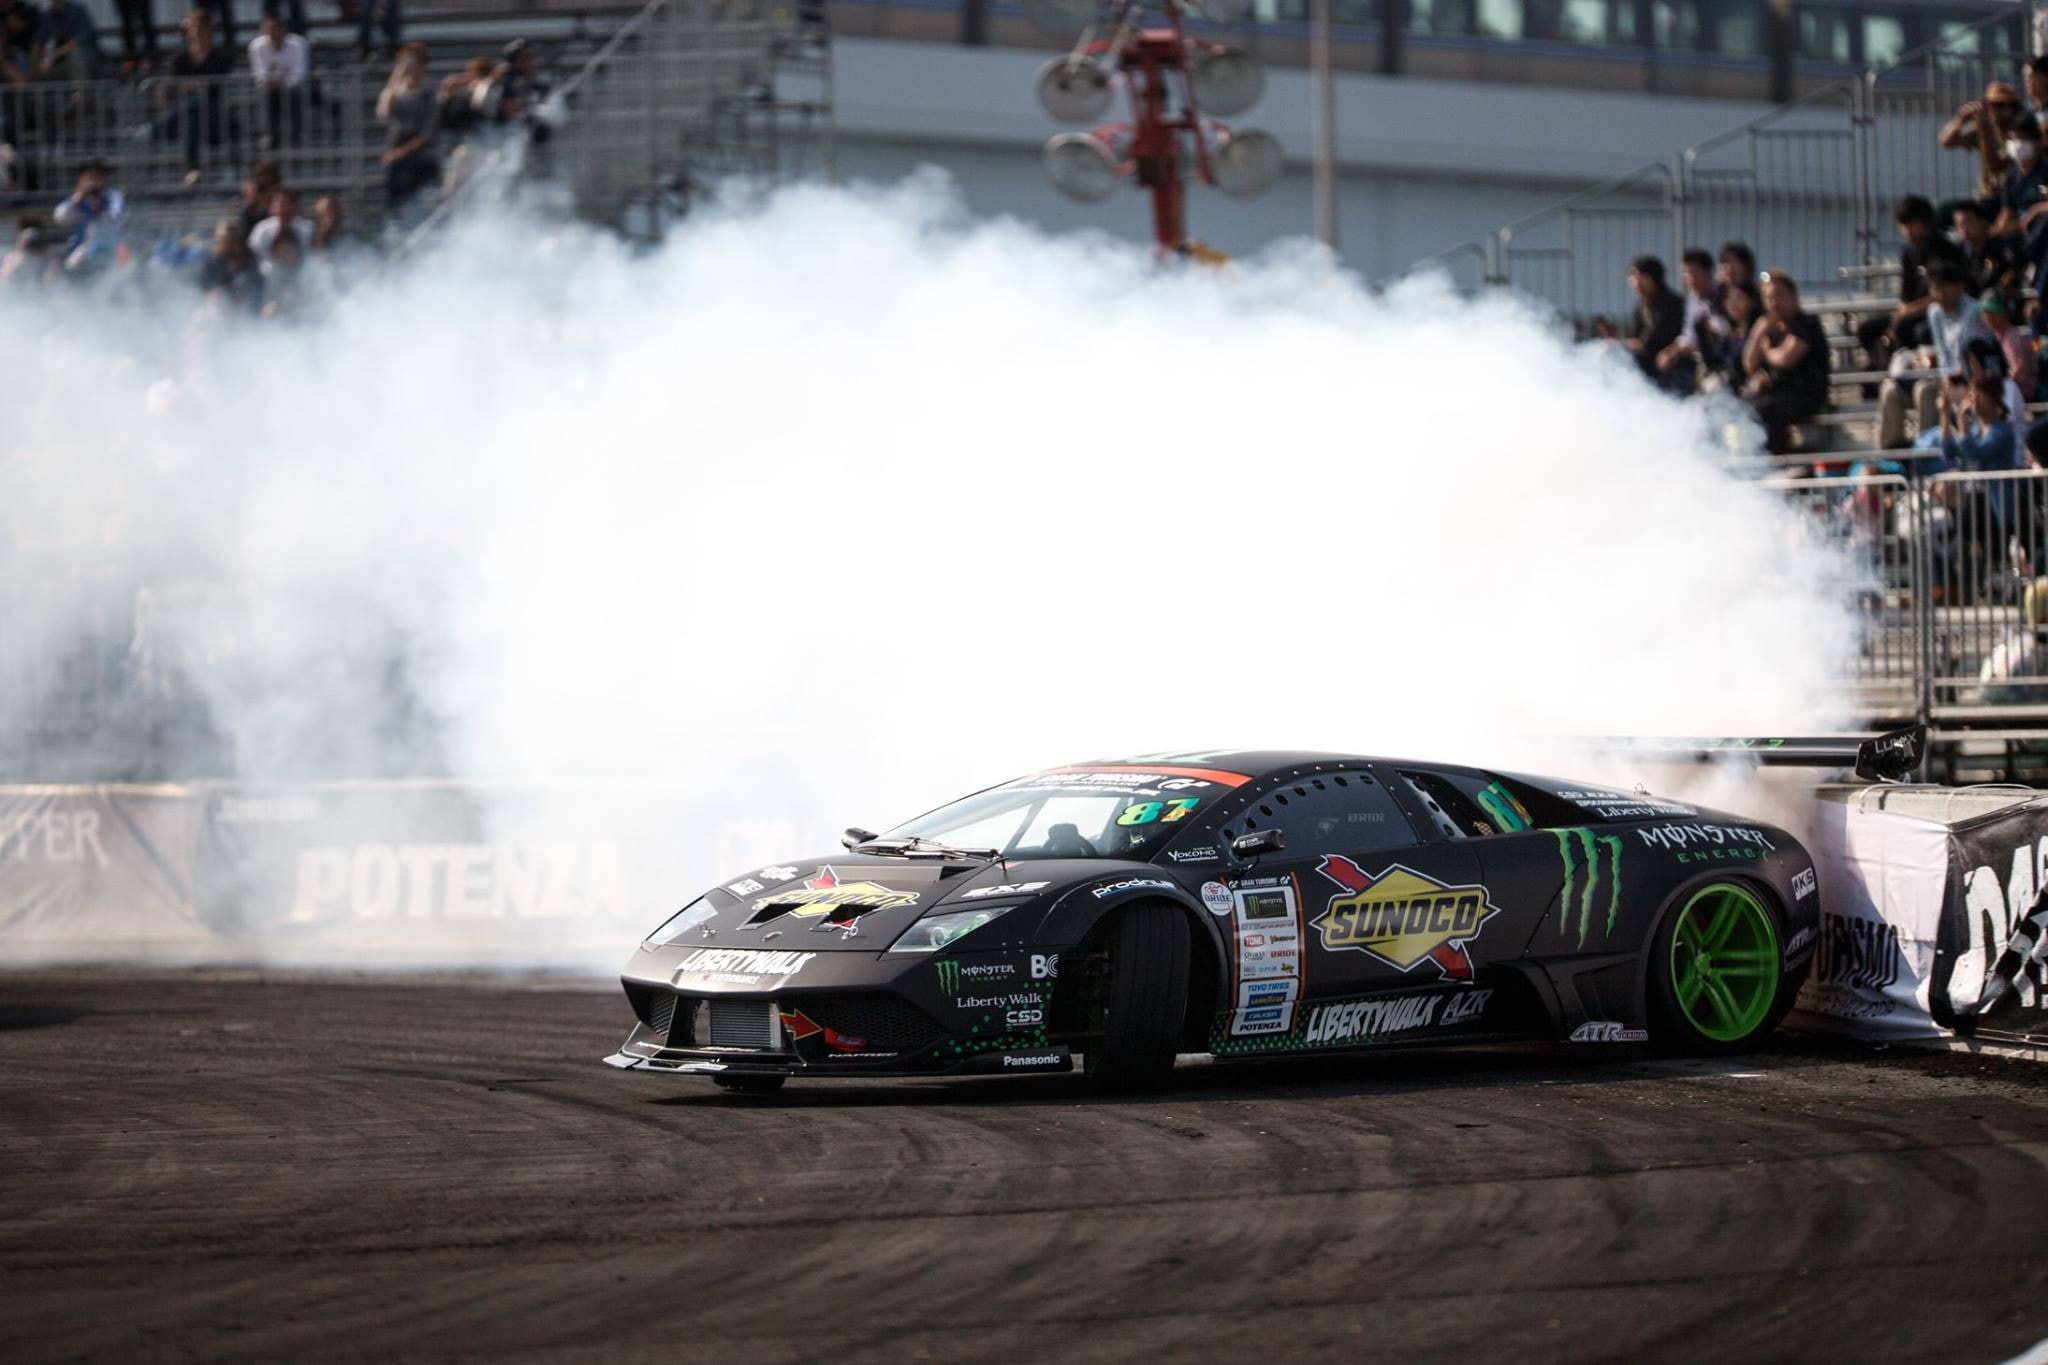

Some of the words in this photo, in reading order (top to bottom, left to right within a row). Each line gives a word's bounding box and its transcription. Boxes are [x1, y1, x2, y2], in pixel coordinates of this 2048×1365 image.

[1115, 797, 1201, 826] 87
[1477, 780, 1535, 834] 87
[1637, 823, 1776, 851] MONSTER
[296, 843, 627, 921] POTENZA
[1330, 895, 1479, 940] SUNOCO
[961, 965, 1016, 976] MONSTER
[957, 996, 1007, 1009] Liberty
[1009, 993, 1043, 1005] Walk
[1006, 1010, 1043, 1024] CSD
[1239, 1021, 1282, 1032] POTENZA
[1305, 994, 1443, 1043] LIBERTYWALK
[1003, 1053, 1061, 1067] Panasonic
